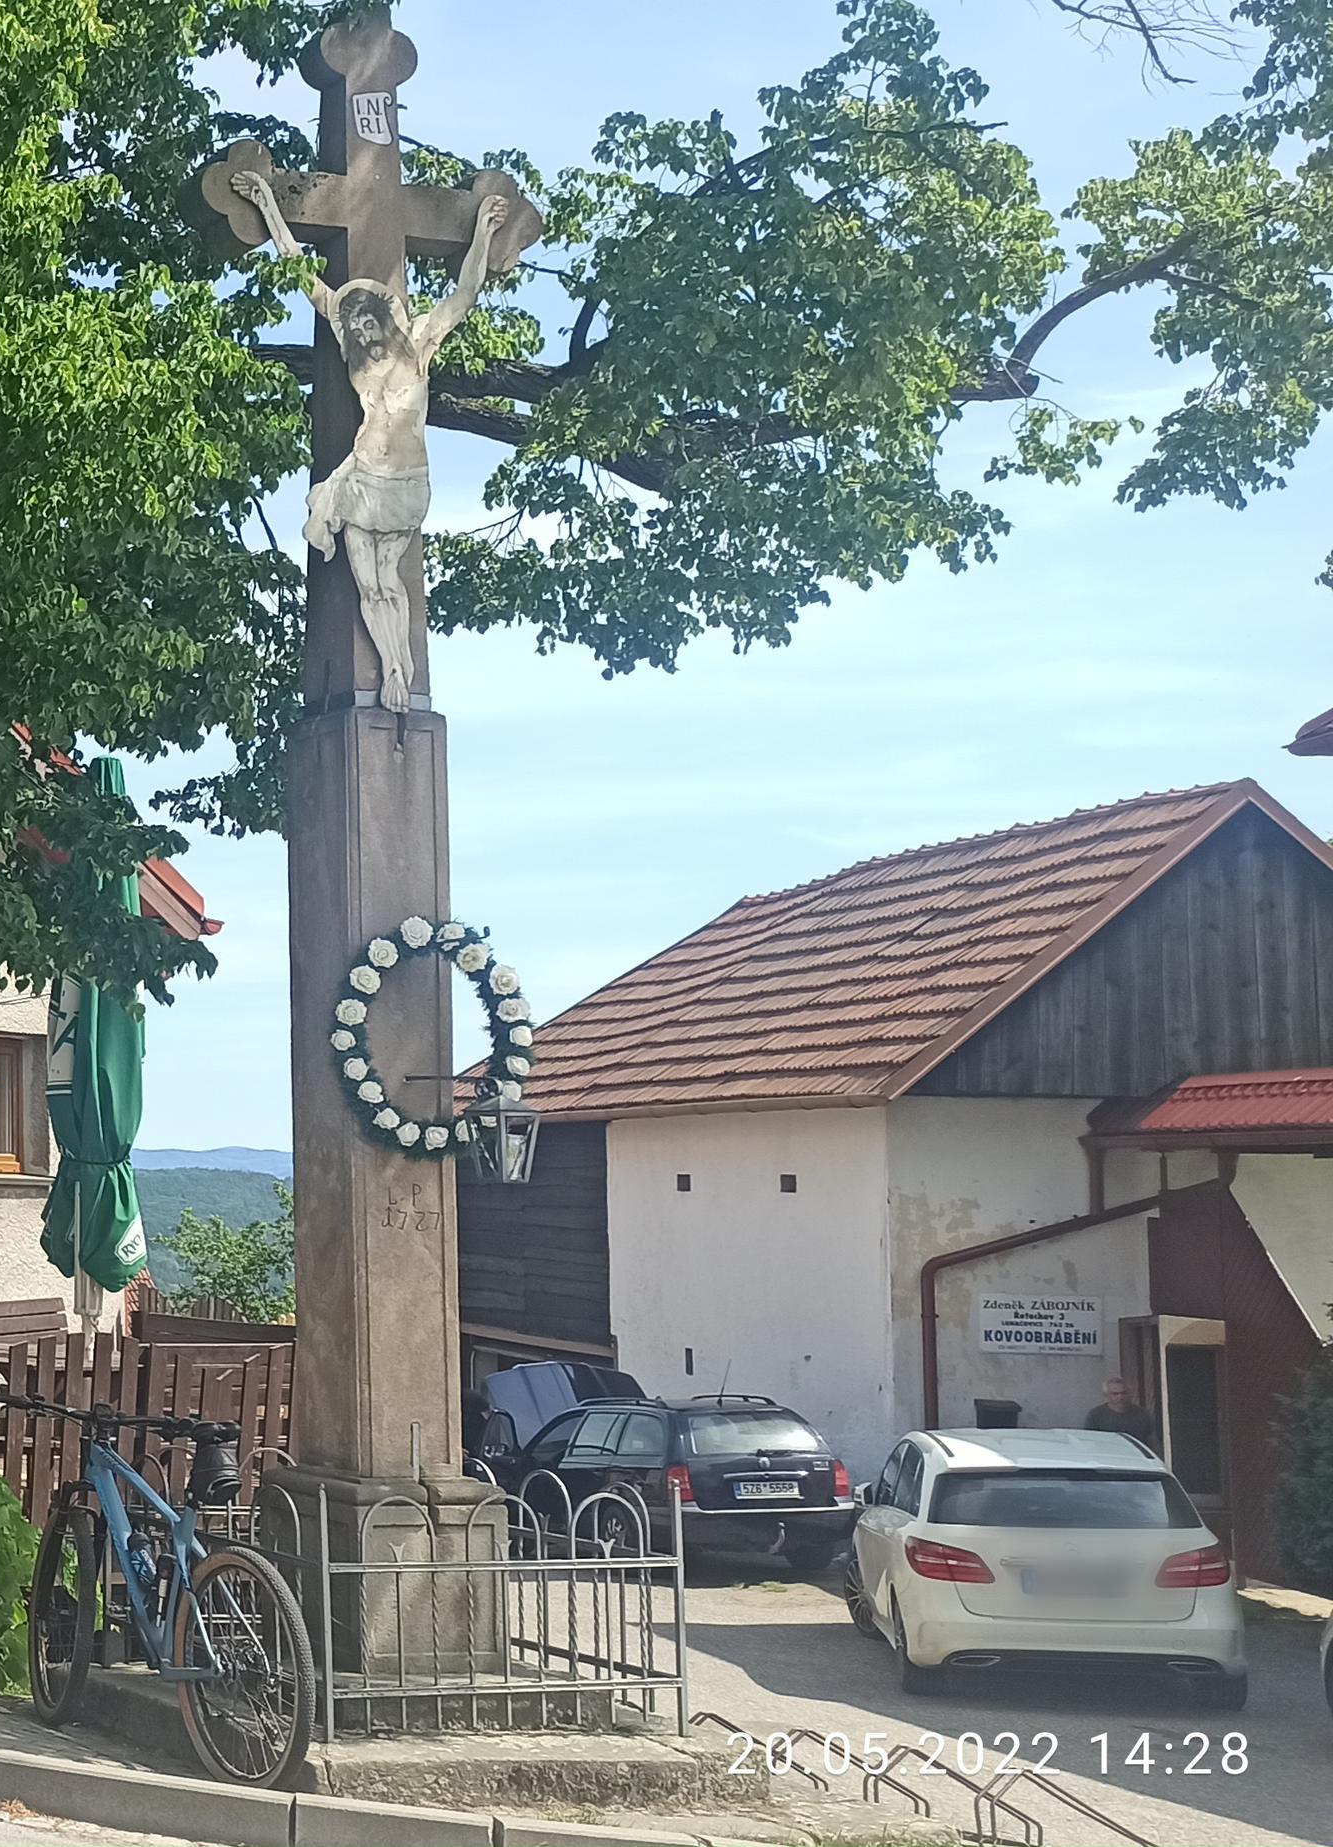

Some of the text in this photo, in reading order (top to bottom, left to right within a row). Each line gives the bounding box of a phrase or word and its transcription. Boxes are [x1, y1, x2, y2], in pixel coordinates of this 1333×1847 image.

[983, 1299, 1095, 1311] Zdeněk ZÁBOJNÍK
[984, 1329, 1097, 1344] KOVOOBRÁBĚNÍ
